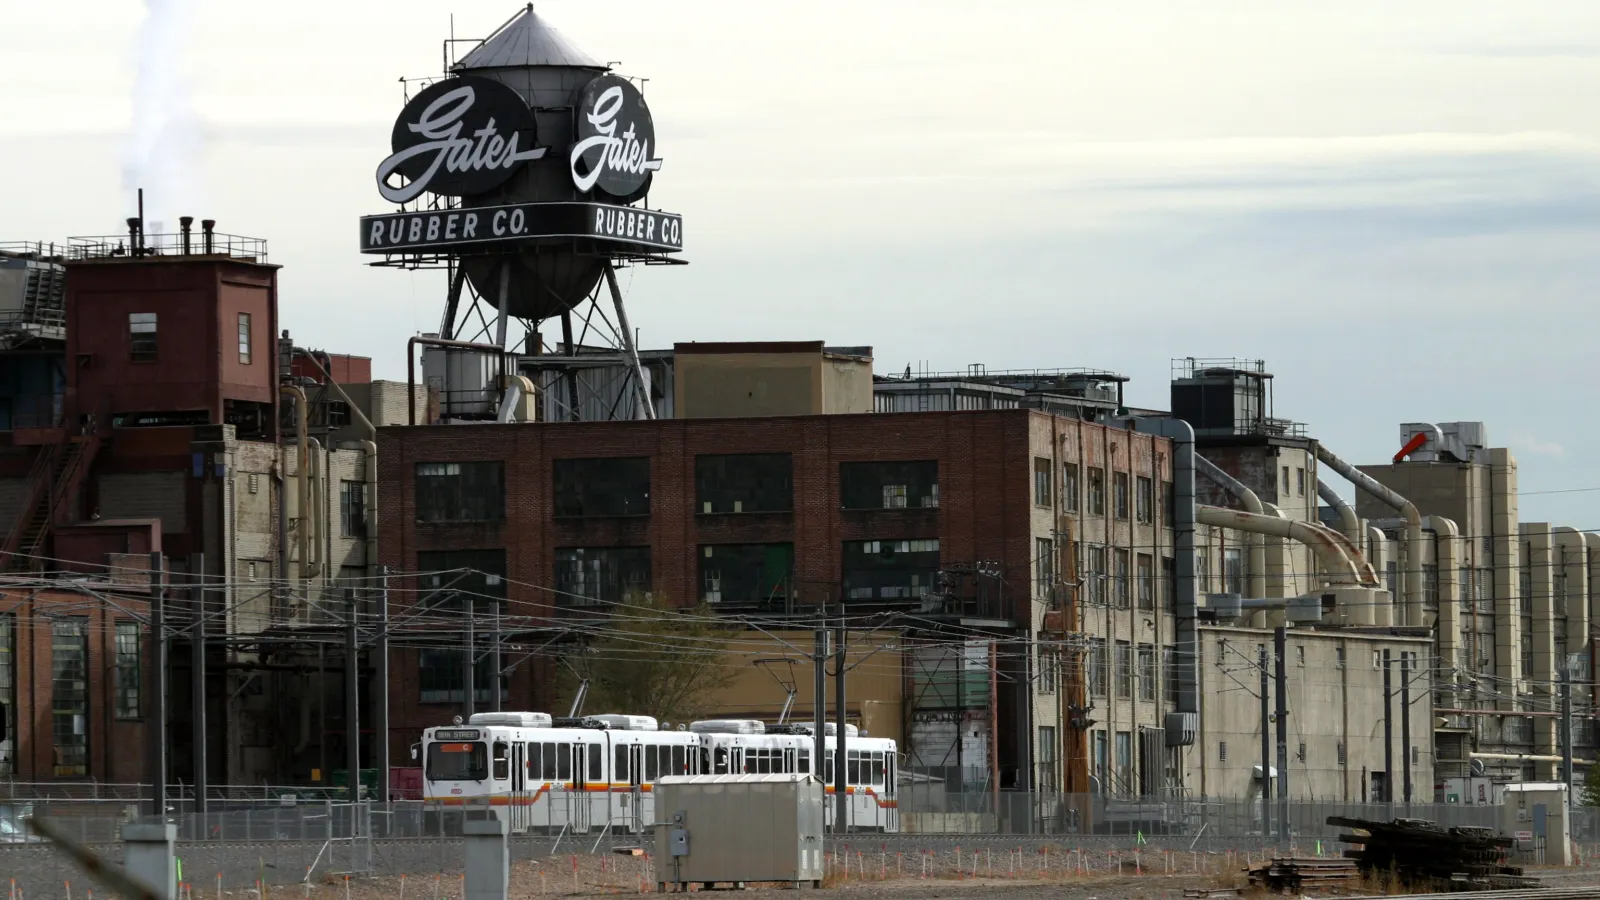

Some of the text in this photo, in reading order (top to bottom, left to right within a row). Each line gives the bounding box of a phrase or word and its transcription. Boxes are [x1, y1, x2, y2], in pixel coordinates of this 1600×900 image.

[376, 85, 548, 203] Gates
[570, 85, 664, 193] Gates
[369, 208, 529, 246] RUBBER CO.
[595, 207, 681, 245] RUBBER CO.
